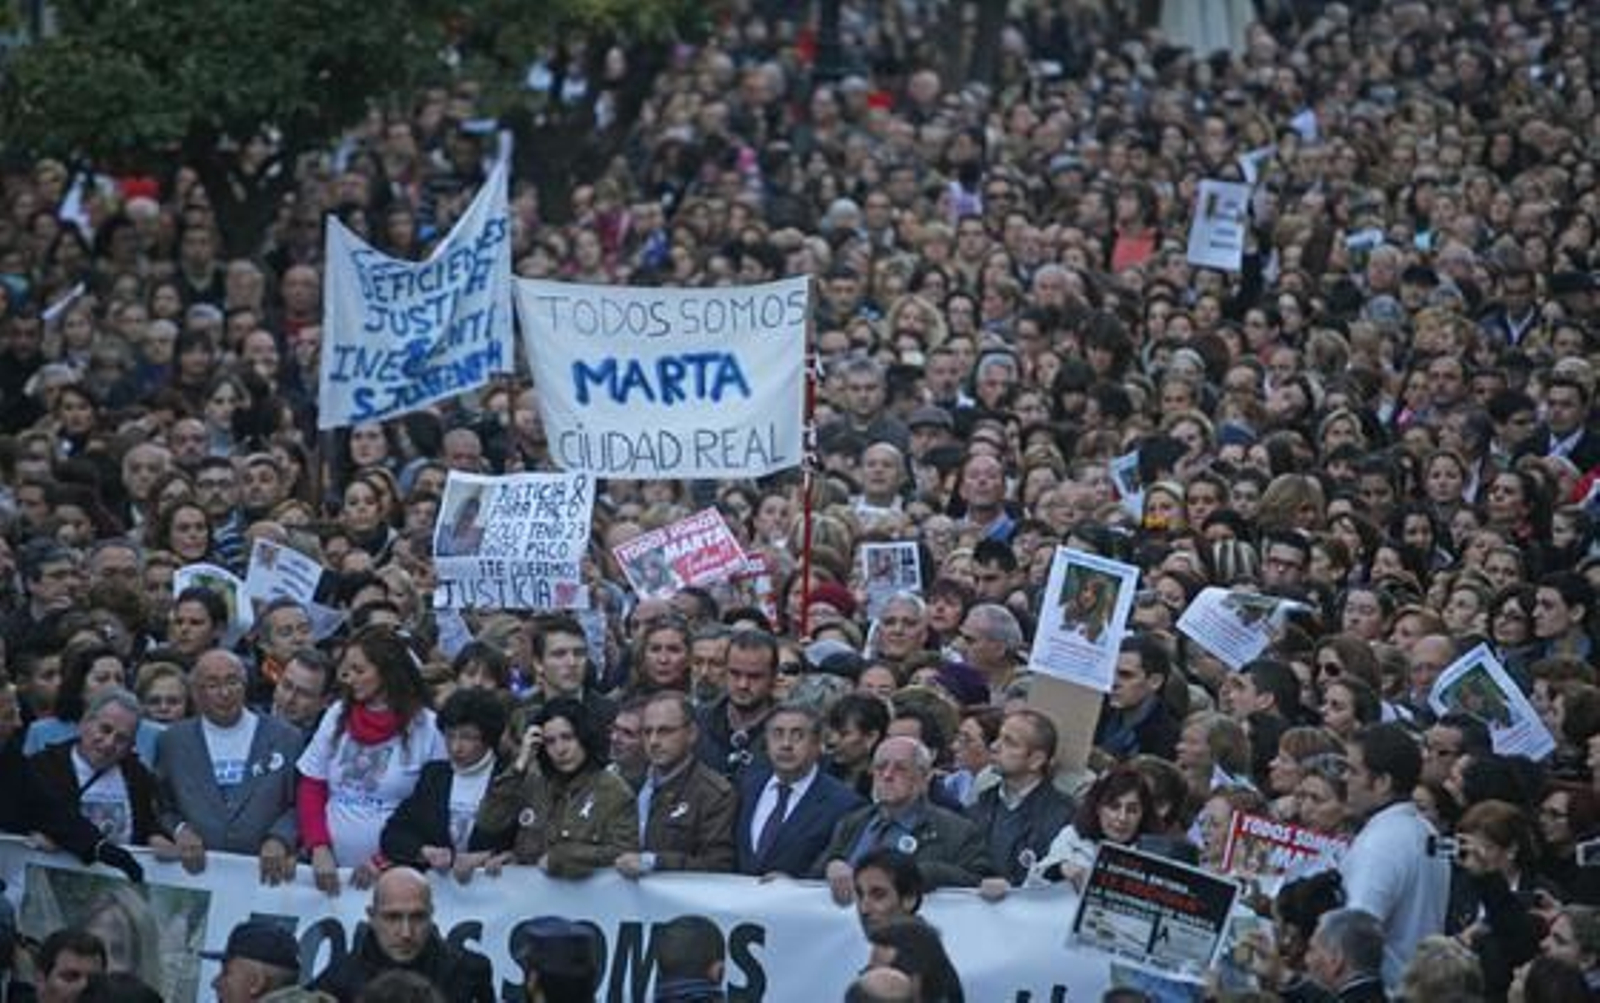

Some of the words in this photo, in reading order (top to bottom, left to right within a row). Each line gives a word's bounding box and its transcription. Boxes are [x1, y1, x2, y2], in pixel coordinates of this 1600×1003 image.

[536, 296, 671, 337] TODOS
[680, 289, 806, 335] SOMOS
[571, 351, 752, 405] MARTA
[693, 421, 787, 470] REAL
[533, 499, 581, 520] PACO
[524, 541, 569, 560] PACO
[439, 578, 552, 609] JUSTICIA
[1241, 815, 1292, 842] TODOS
